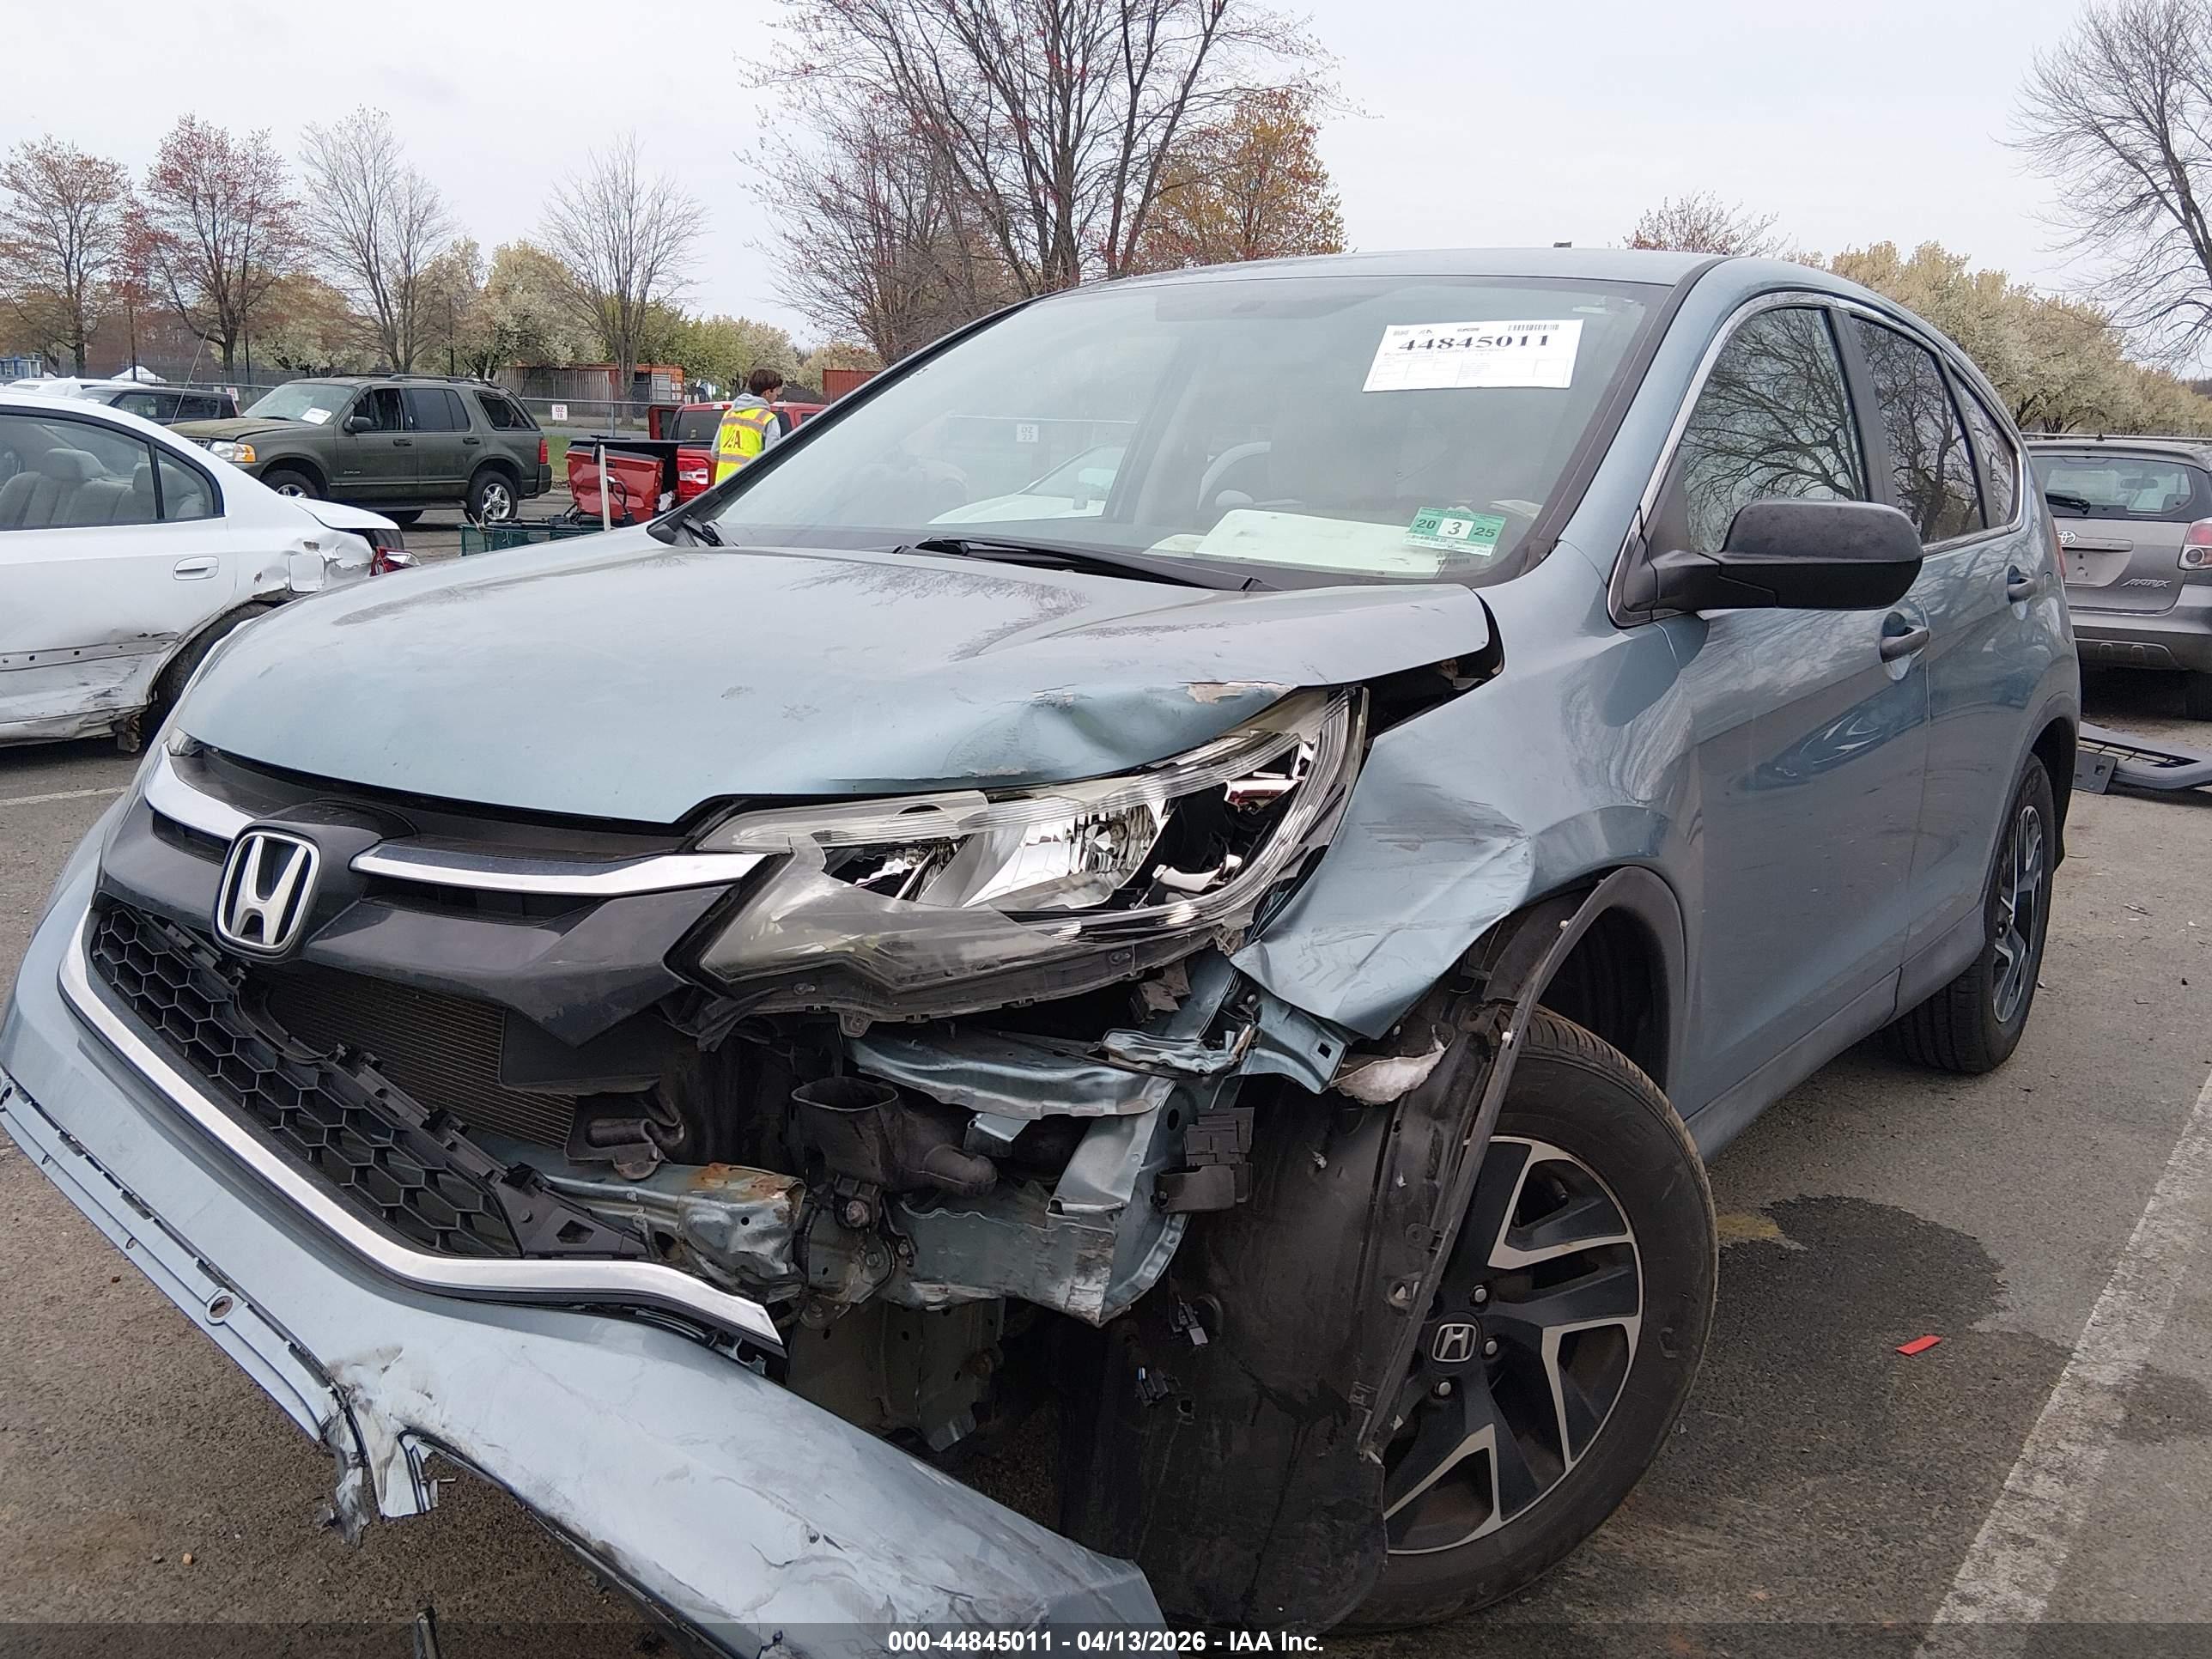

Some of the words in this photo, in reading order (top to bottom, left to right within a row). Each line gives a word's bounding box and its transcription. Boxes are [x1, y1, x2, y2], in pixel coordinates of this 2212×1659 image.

[1399, 335, 1549, 350] 44845011
[1416, 519, 1437, 530] 20
[1447, 521, 1463, 535] 3
[1474, 526, 1497, 538] 25
